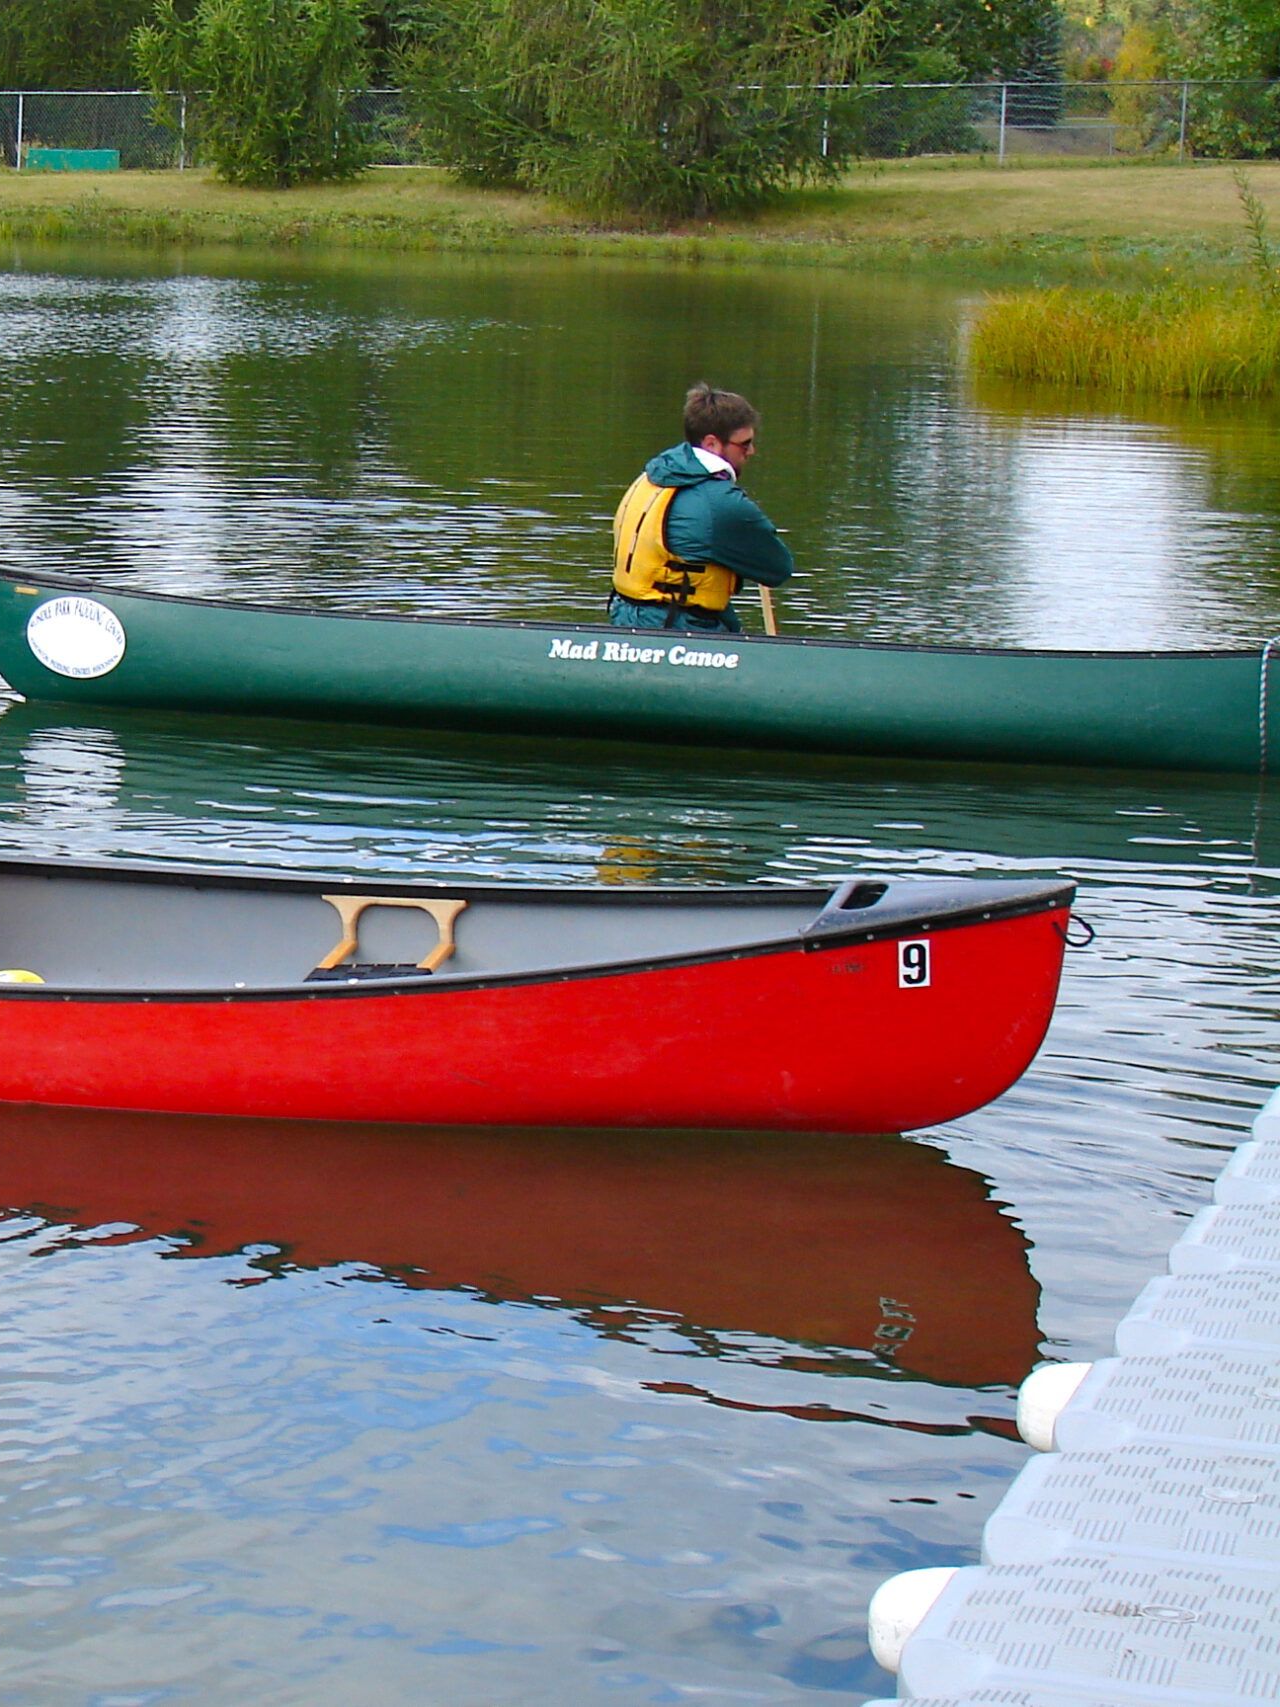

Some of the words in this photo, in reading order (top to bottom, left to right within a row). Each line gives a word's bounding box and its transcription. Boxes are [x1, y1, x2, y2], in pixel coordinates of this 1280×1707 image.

[548, 639, 598, 660] Mad
[602, 641, 666, 664] River
[668, 645, 739, 669] Canoe
[902, 943, 927, 985] 9
